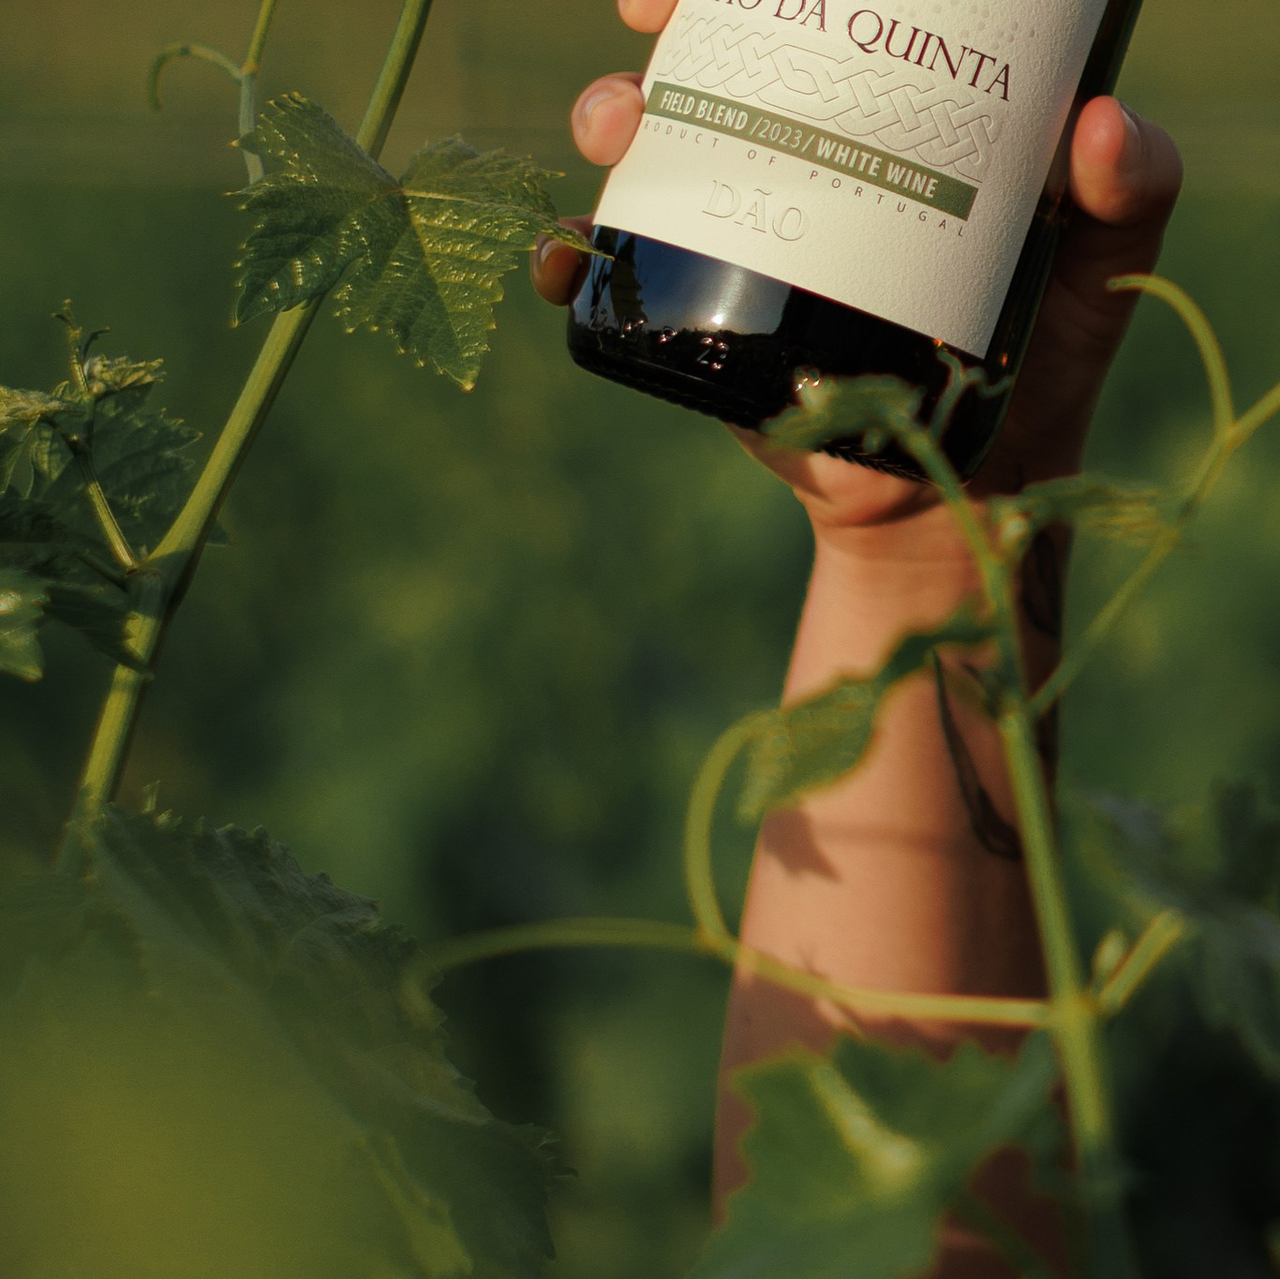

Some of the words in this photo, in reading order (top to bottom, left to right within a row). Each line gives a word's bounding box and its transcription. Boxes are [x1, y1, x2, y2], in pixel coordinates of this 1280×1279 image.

[847, 9, 1011, 102] QUINTA
[643, 120, 719, 148] RODUCT
[747, 149, 776, 166] OF
[809, 170, 965, 237] PORTUGAL
[660, 90, 696, 115] FIELD
[695, 100, 749, 131] BLEND
[816, 137, 882, 178] WHITE
[886, 161, 939, 199] WINE
[702, 179, 810, 241] DÃO
